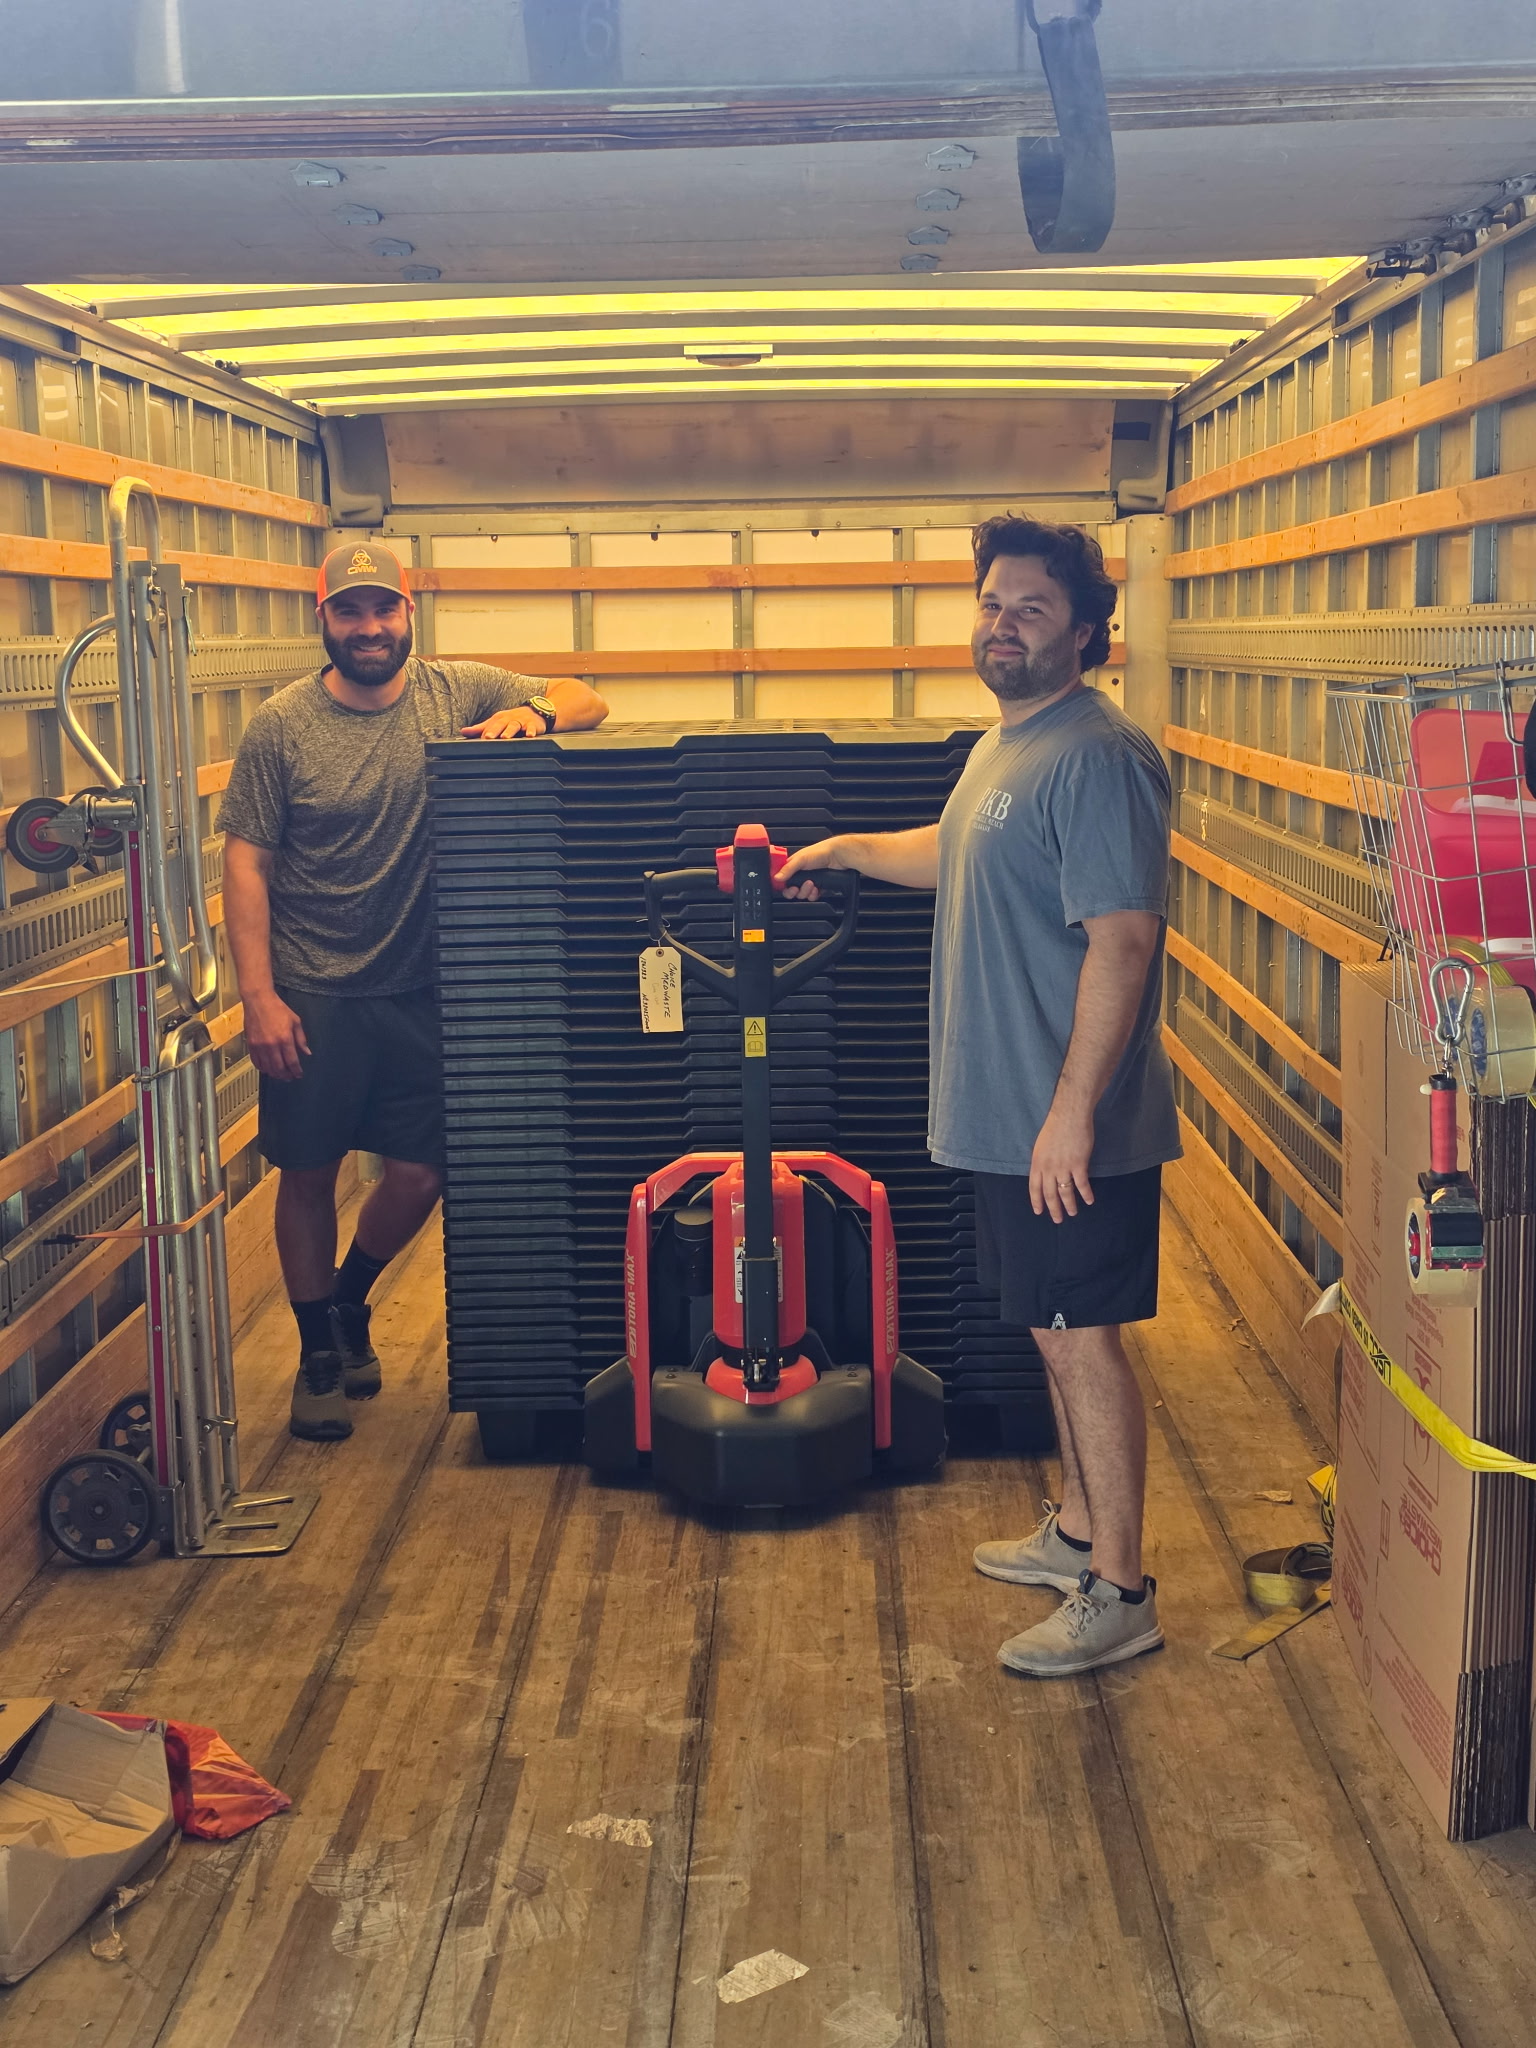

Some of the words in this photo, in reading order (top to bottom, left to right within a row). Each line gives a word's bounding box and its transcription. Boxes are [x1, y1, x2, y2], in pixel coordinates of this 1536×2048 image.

[975, 786, 1012, 820] BKB
[83, 1015, 93, 1062] 6
[626, 1254, 637, 1326] TORA-MAX
[886, 1249, 895, 1325] TORA-MAX
[1404, 1510, 1442, 1577] CHOICE
